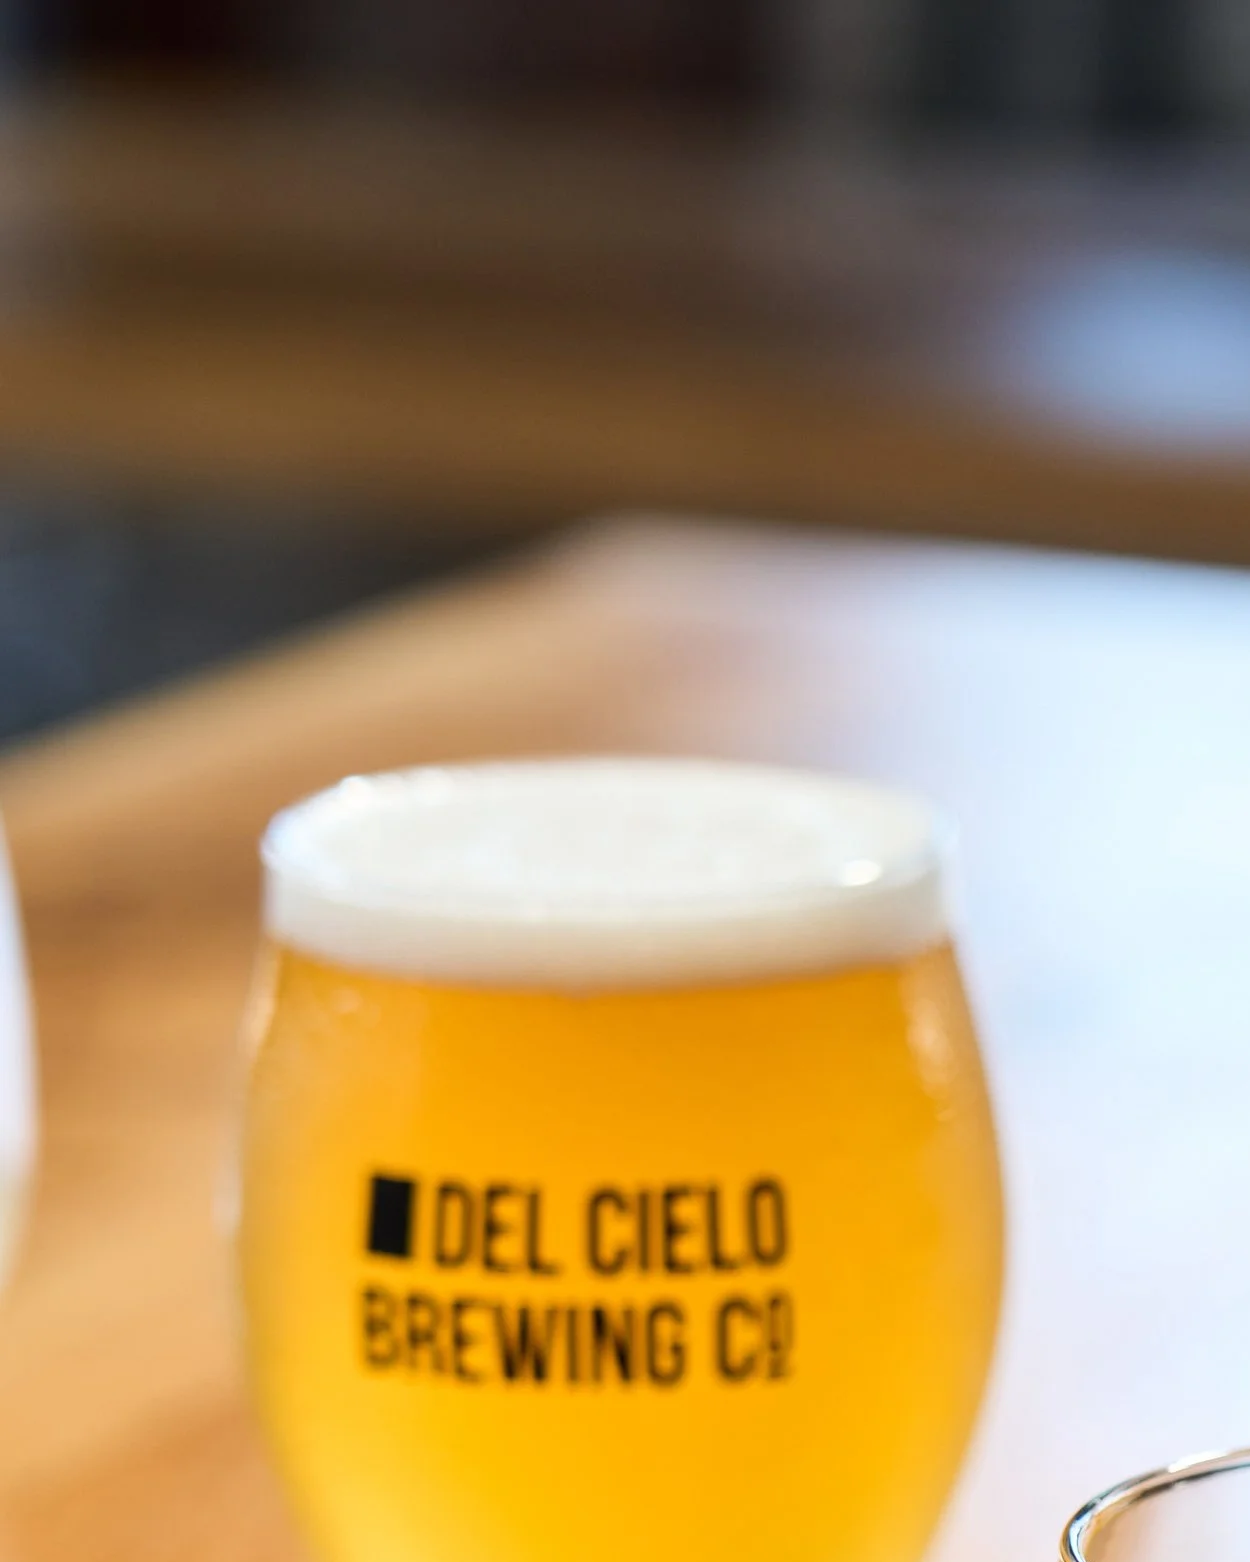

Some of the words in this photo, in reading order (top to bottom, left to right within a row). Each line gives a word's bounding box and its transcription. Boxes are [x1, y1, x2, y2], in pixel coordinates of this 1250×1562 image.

[432, 1182, 562, 1275] DEL
[587, 1176, 788, 1277] CIELO
[361, 1284, 687, 1386] BREWING
